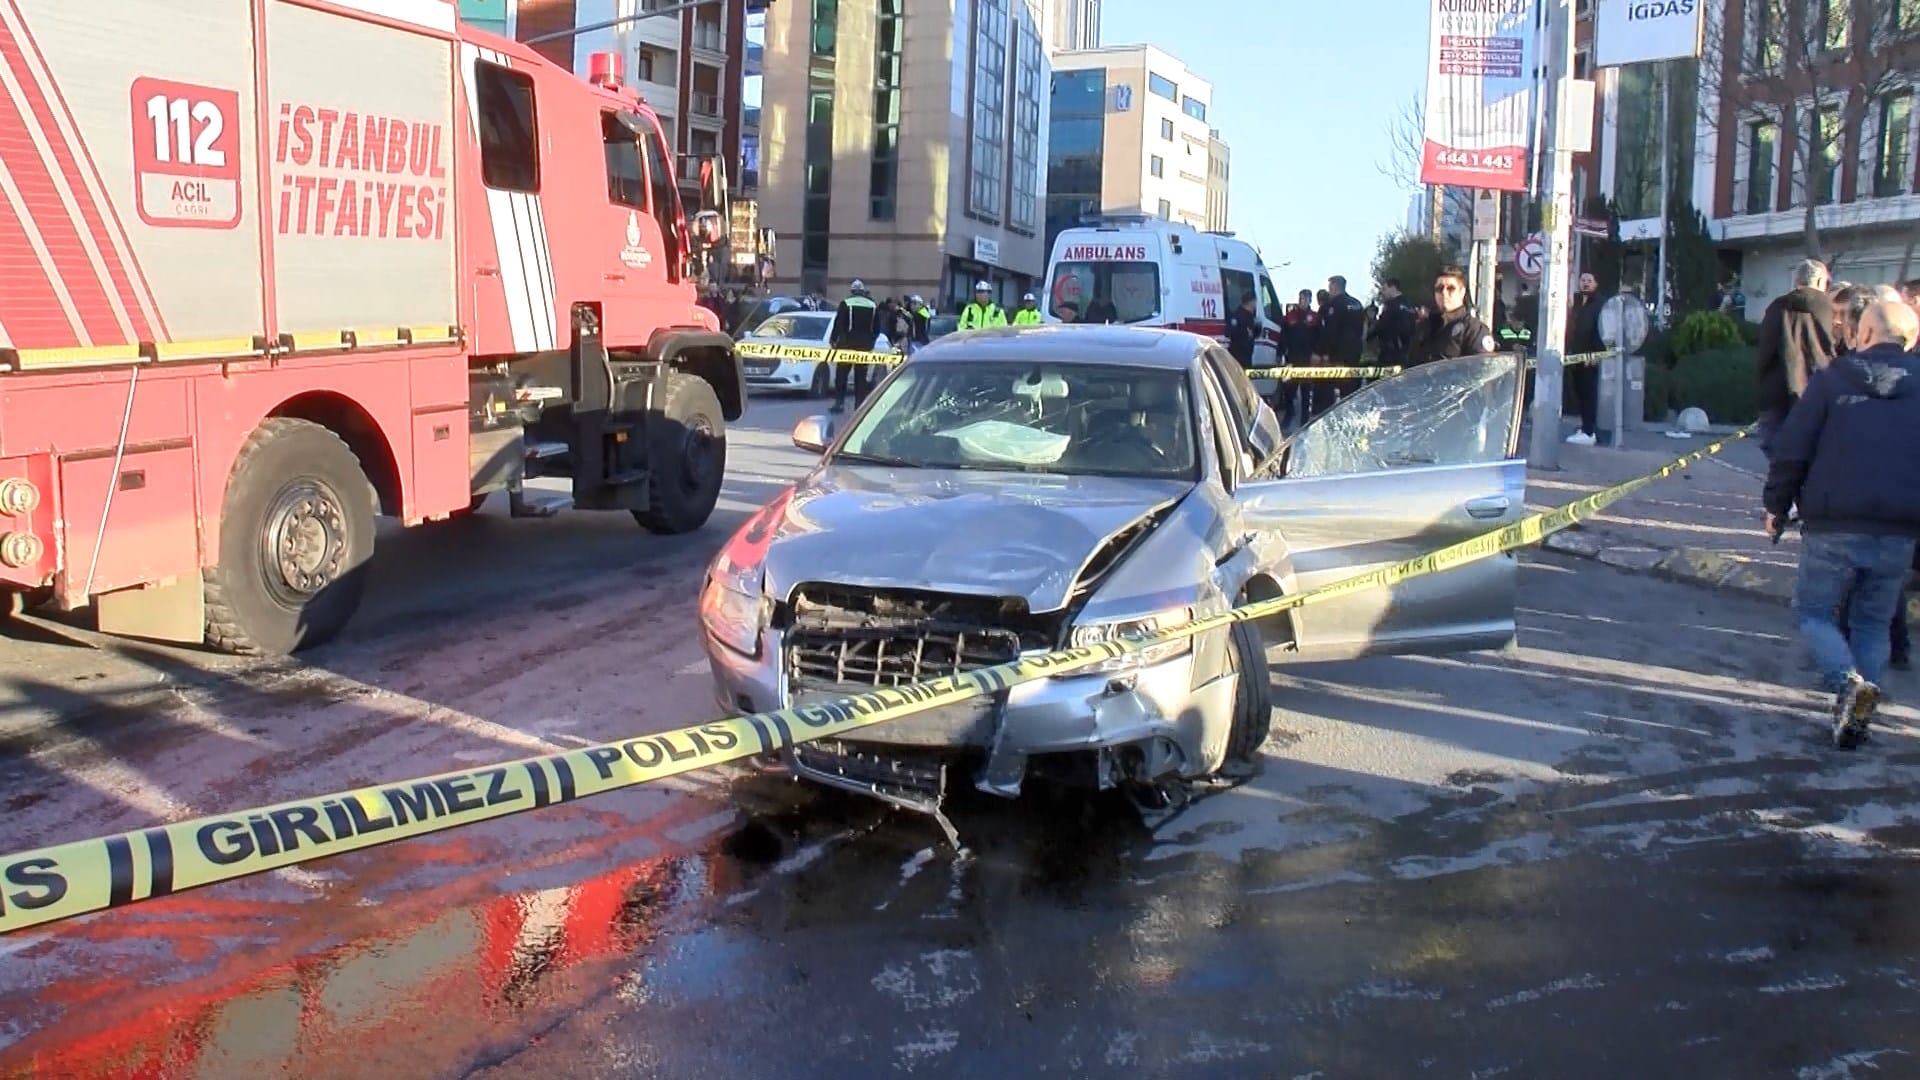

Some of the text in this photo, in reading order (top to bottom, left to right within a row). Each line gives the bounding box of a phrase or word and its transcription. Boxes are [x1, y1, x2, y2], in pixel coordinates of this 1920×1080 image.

[146, 95, 226, 168] 112
[276, 103, 446, 179] İSTANBUL
[1436, 151, 1467, 166] 444
[1471, 153, 1479, 166] 1
[171, 181, 211, 202] ACİL
[278, 175, 446, 240] İTFAİYESİ
[1064, 246, 1146, 261] AMBULANS
[1200, 297, 1217, 319] 112
[0, 857, 68, 918] S
[196, 766, 522, 866] GİRİLMEZ
[585, 722, 739, 781] POLİS
